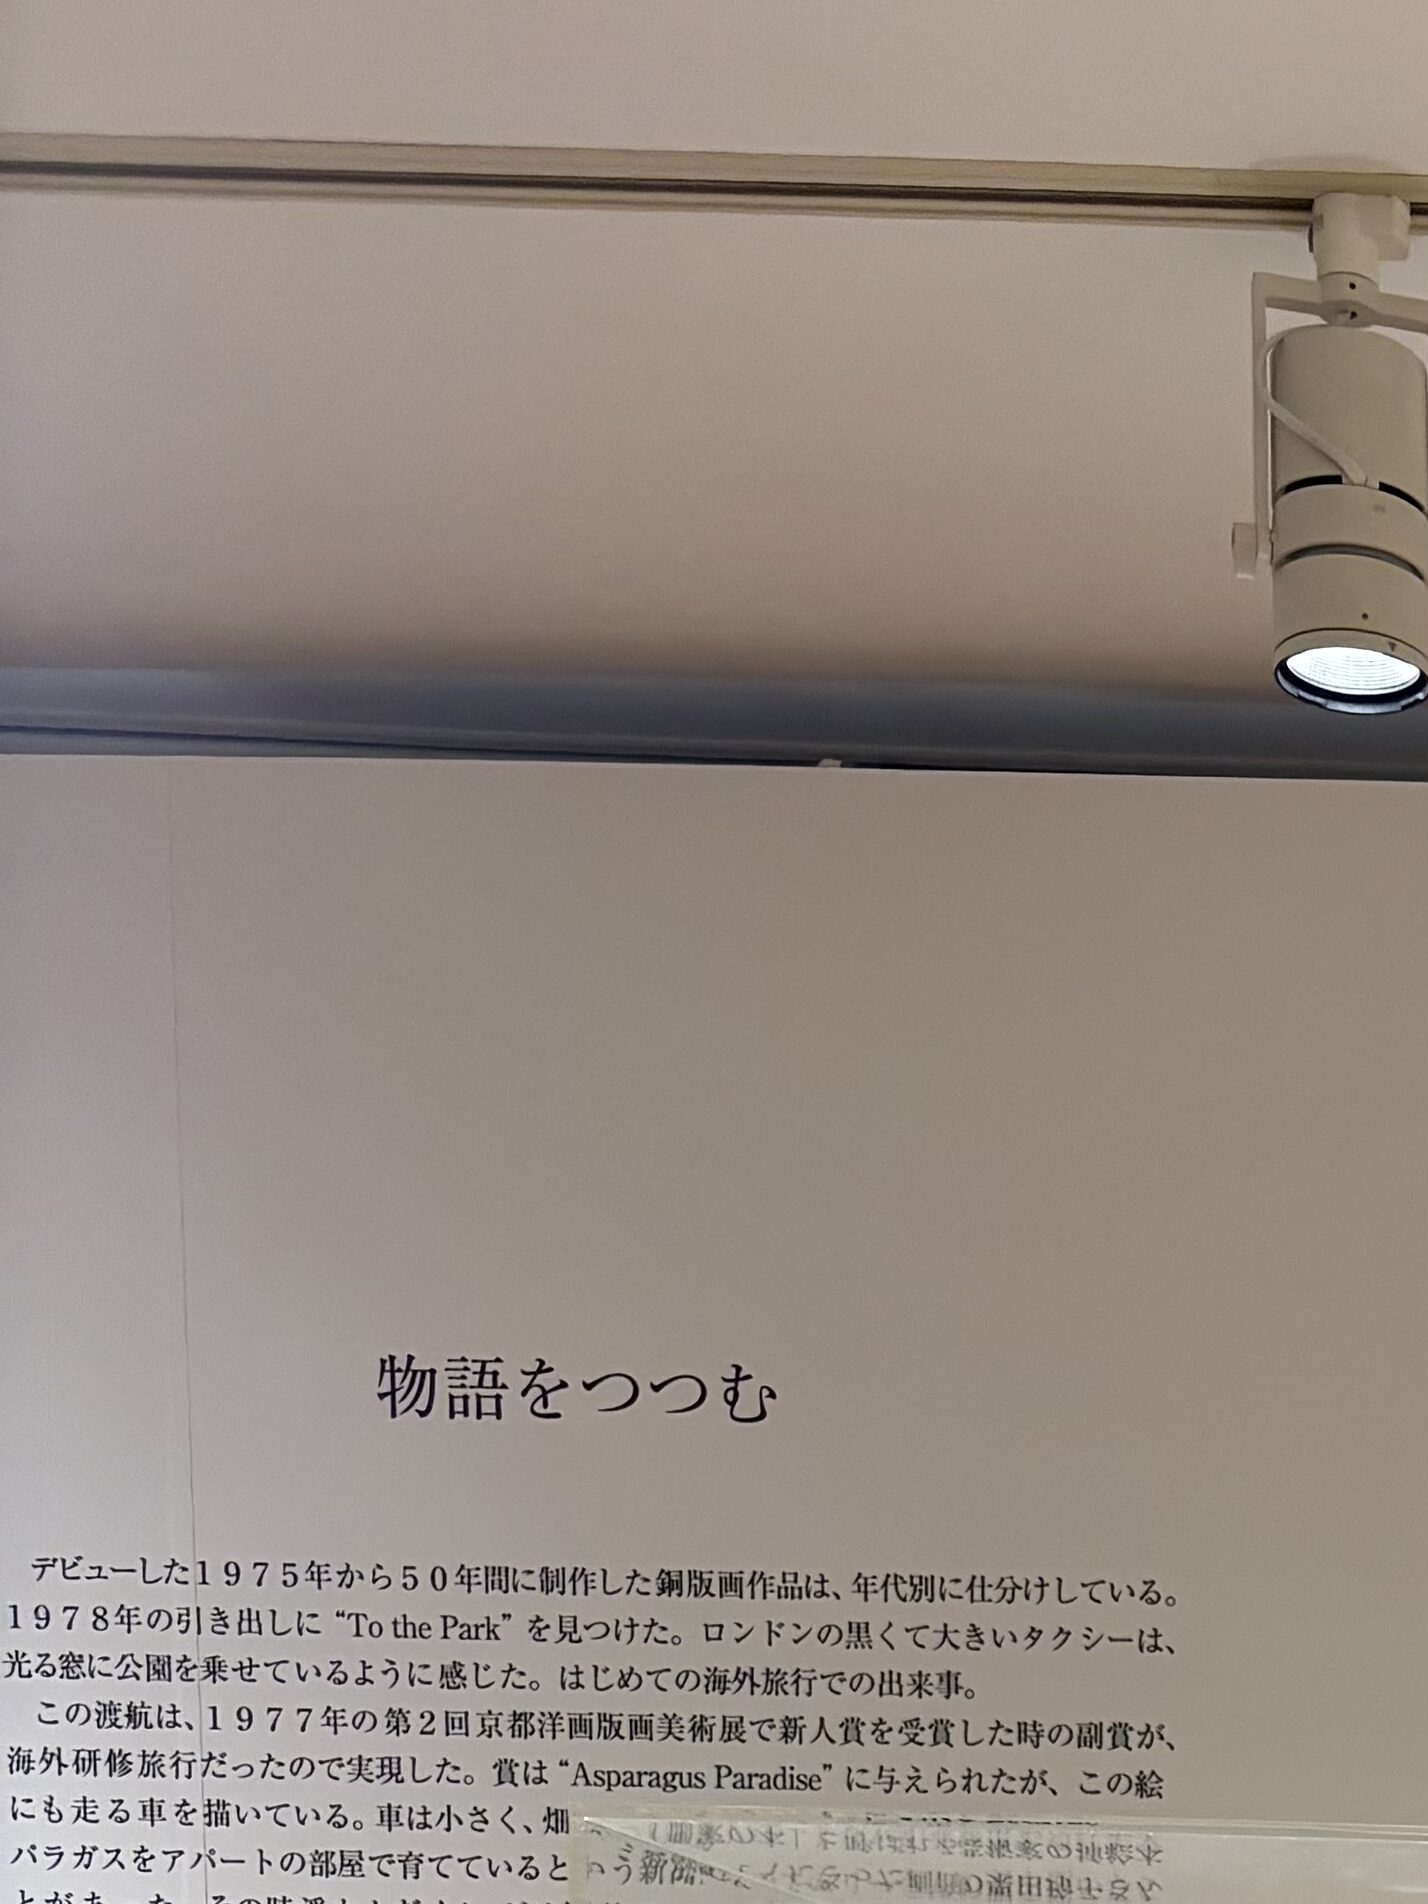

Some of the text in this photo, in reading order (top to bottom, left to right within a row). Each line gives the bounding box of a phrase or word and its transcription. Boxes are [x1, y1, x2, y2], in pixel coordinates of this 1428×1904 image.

[376, 1353, 778, 1424] 物語をつつむ
[391, 1613, 433, 1640] the
[846, 1764, 1165, 1800] に与えられたが、この絵
